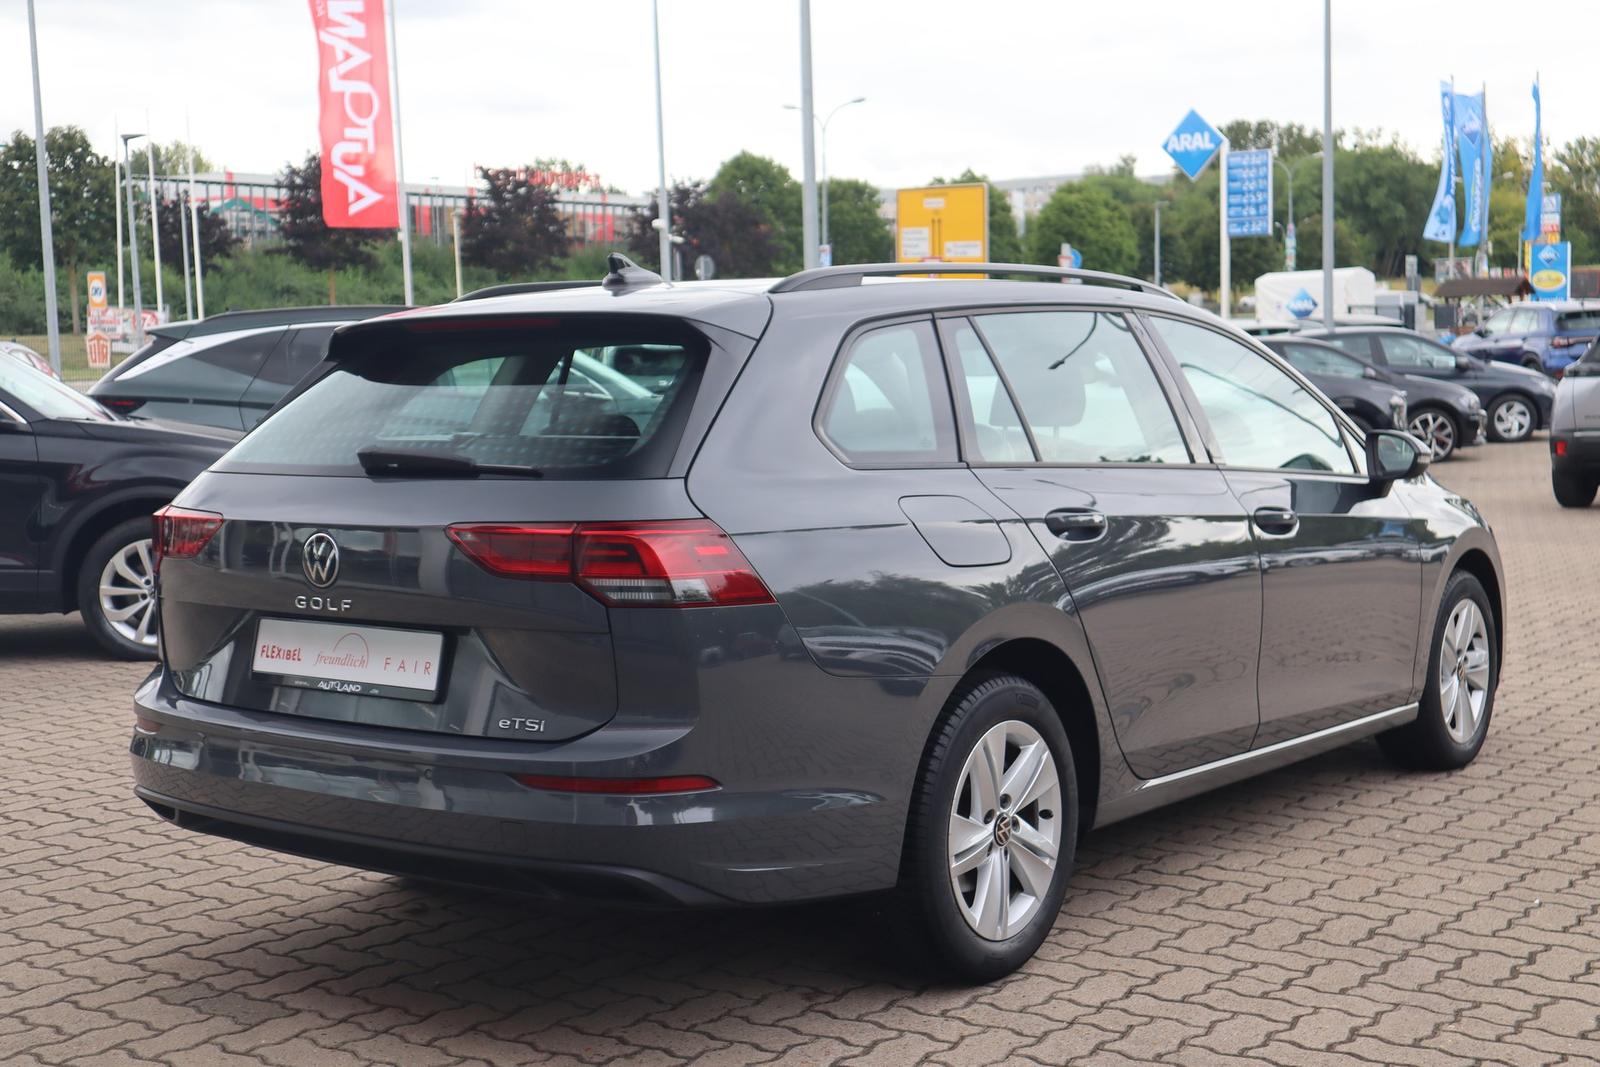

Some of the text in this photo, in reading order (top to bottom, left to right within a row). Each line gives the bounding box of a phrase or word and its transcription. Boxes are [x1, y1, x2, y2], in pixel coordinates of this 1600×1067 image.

[1167, 131, 1215, 153] ARAL
[294, 595, 352, 612] GOLF
[260, 644, 432, 676] FLEXIBEL freundlich FAIR
[317, 680, 362, 693] AUTOLAND
